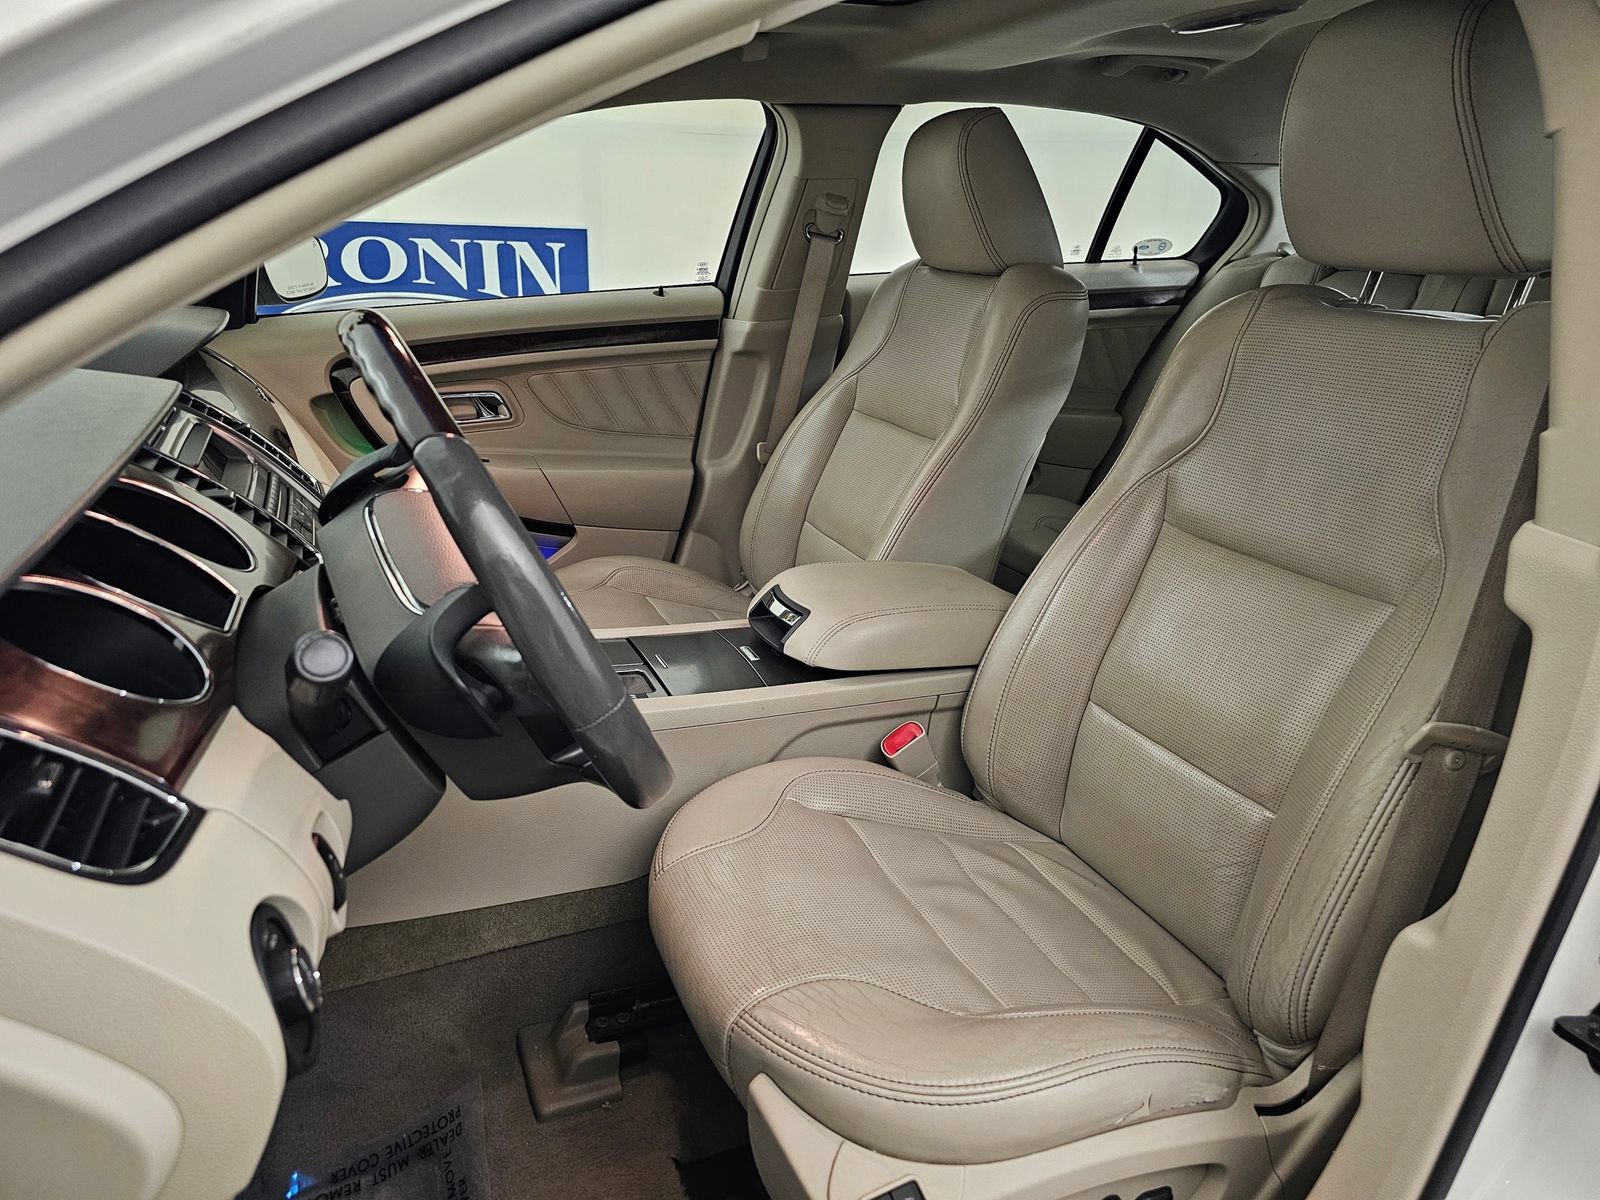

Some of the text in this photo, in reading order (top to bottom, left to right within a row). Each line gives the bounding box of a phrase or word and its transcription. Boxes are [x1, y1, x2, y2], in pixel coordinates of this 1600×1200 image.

[308, 1122, 462, 1200] DEALER MUST REMO
[331, 1105, 462, 1184] PROTECTIVE COVER
